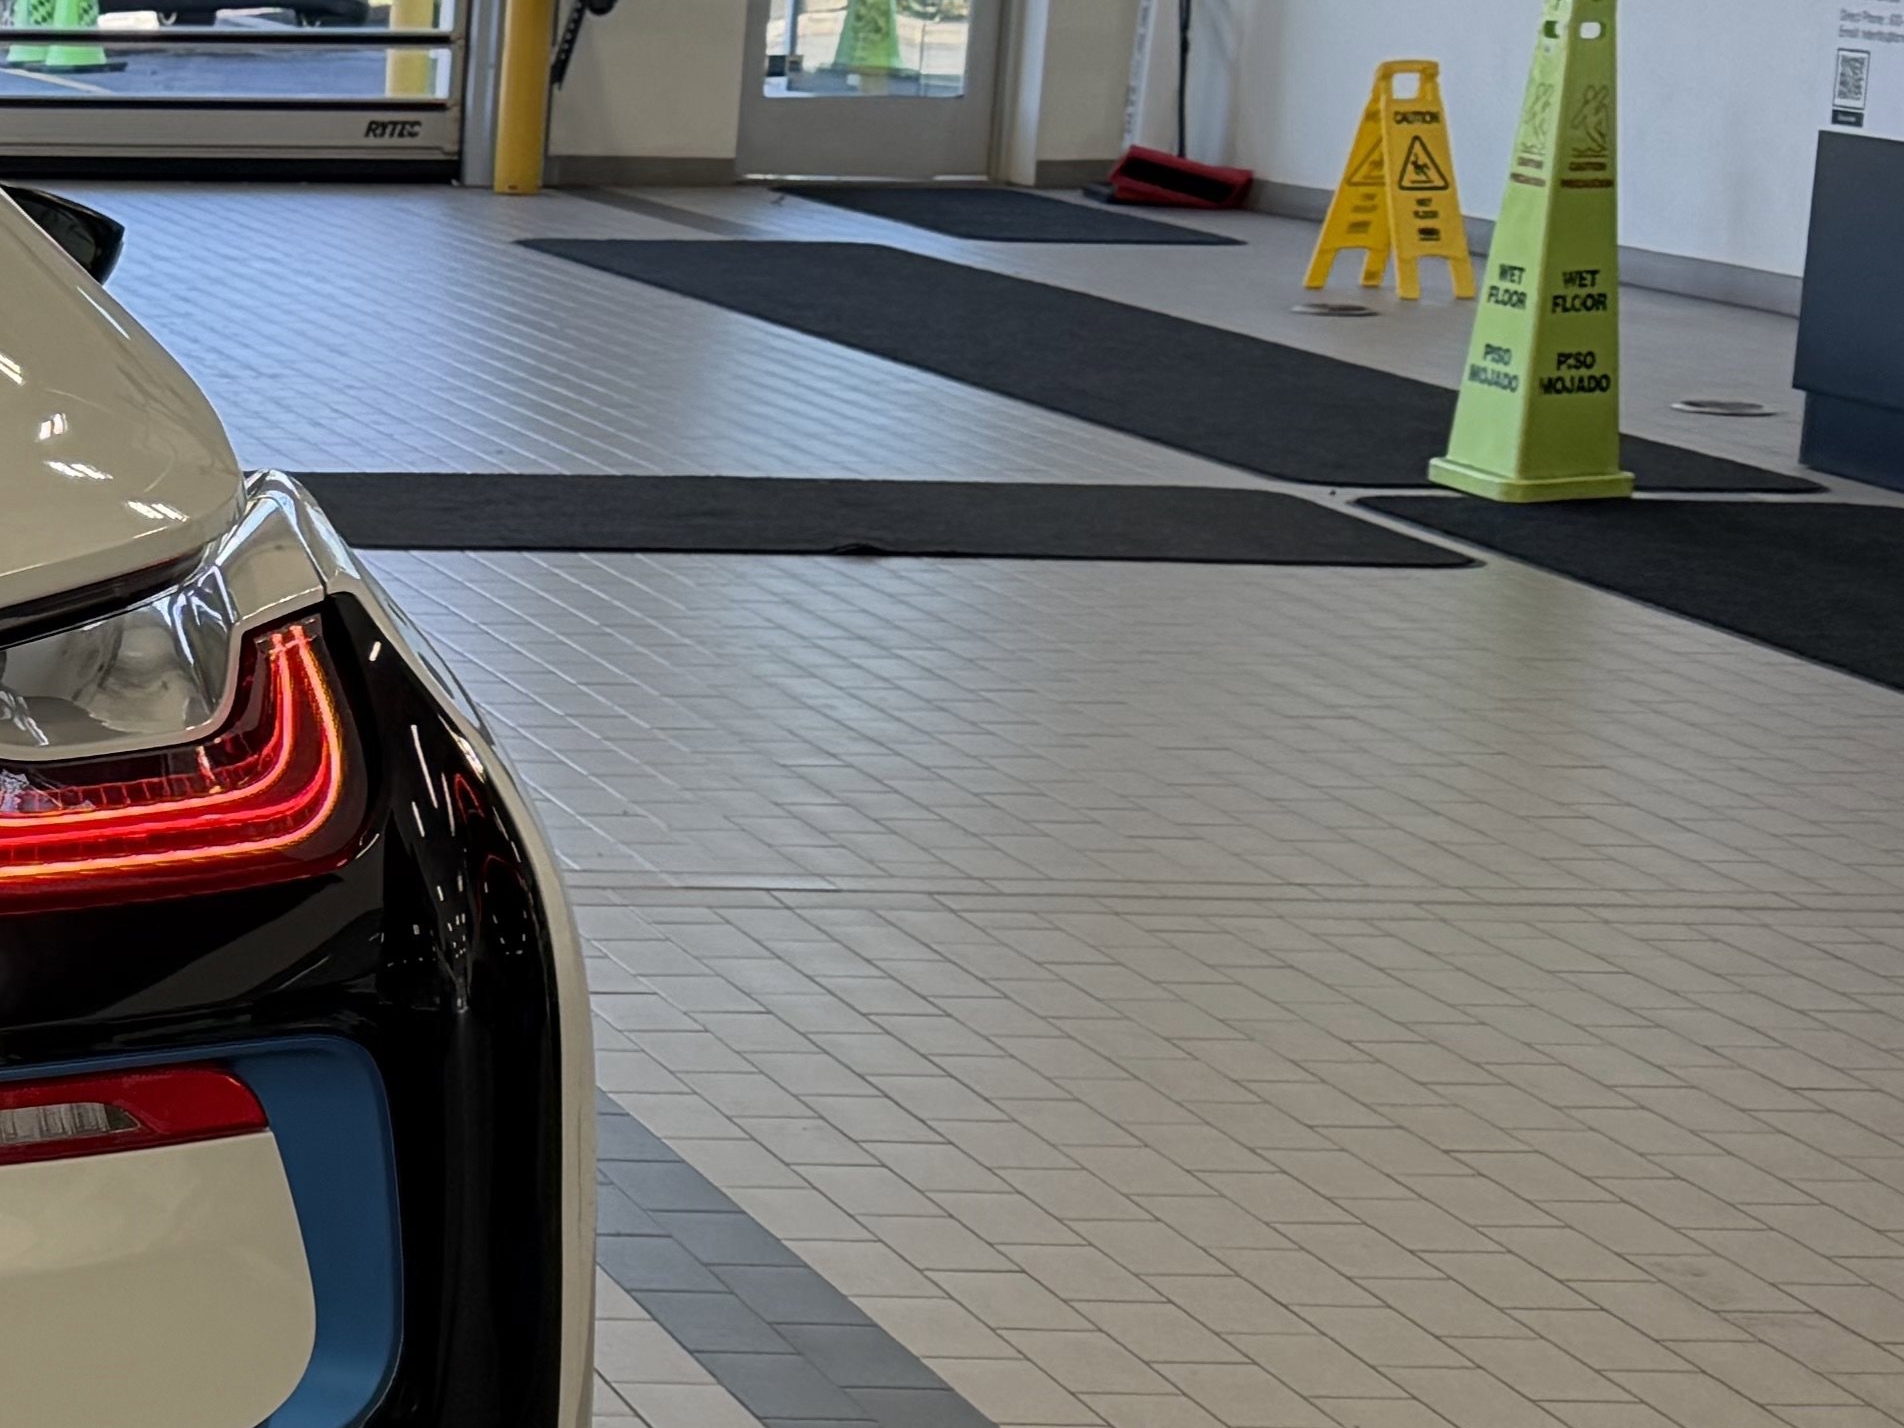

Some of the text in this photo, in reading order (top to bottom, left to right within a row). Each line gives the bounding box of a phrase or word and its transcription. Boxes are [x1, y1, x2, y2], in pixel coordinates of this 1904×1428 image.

[364, 120, 422, 138] RYTEC
[1499, 263, 1526, 285] WET
[1562, 269, 1600, 288] WET
[1487, 285, 1528, 310] FLOOR
[1551, 293, 1608, 314] FLOOR
[1482, 343, 1513, 366] PISO
[1556, 351, 1596, 371] PISO
[1539, 374, 1612, 395] MOJADO
